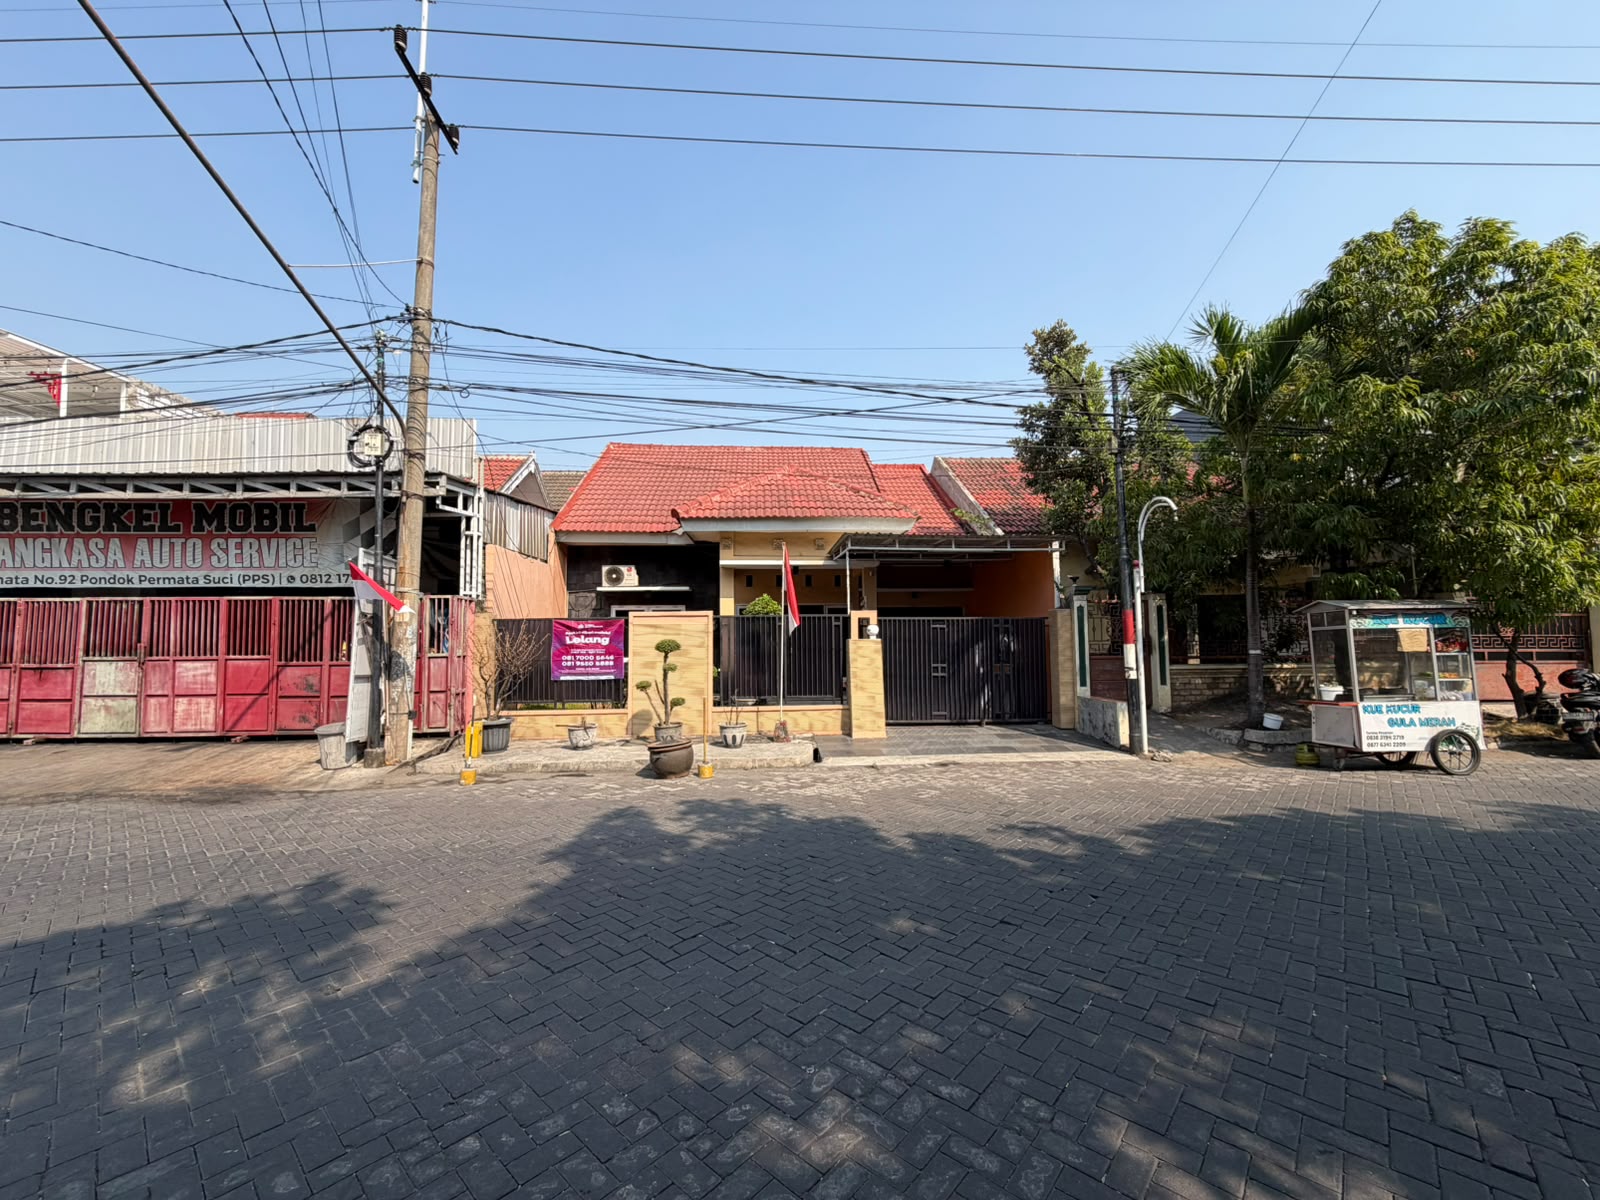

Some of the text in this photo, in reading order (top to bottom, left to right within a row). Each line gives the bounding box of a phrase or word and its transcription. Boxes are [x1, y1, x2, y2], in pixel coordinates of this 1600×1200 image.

[0, 501, 317, 534] BENGKEL MOBIL
[0, 537, 318, 568] ANGKASA AUTO SERVICE
[34, 574, 76, 585] No.92
[80, 574, 134, 585] Pondok
[138, 574, 199, 585] Permata
[203, 574, 233, 585] Suci
[237, 573, 276, 586] (PPS)
[299, 574, 332, 585] 0812
[565, 635, 610, 646] Lelang
[1362, 703, 1421, 714] KUE KUCUR
[1387, 717, 1456, 727] GULA MERAH
